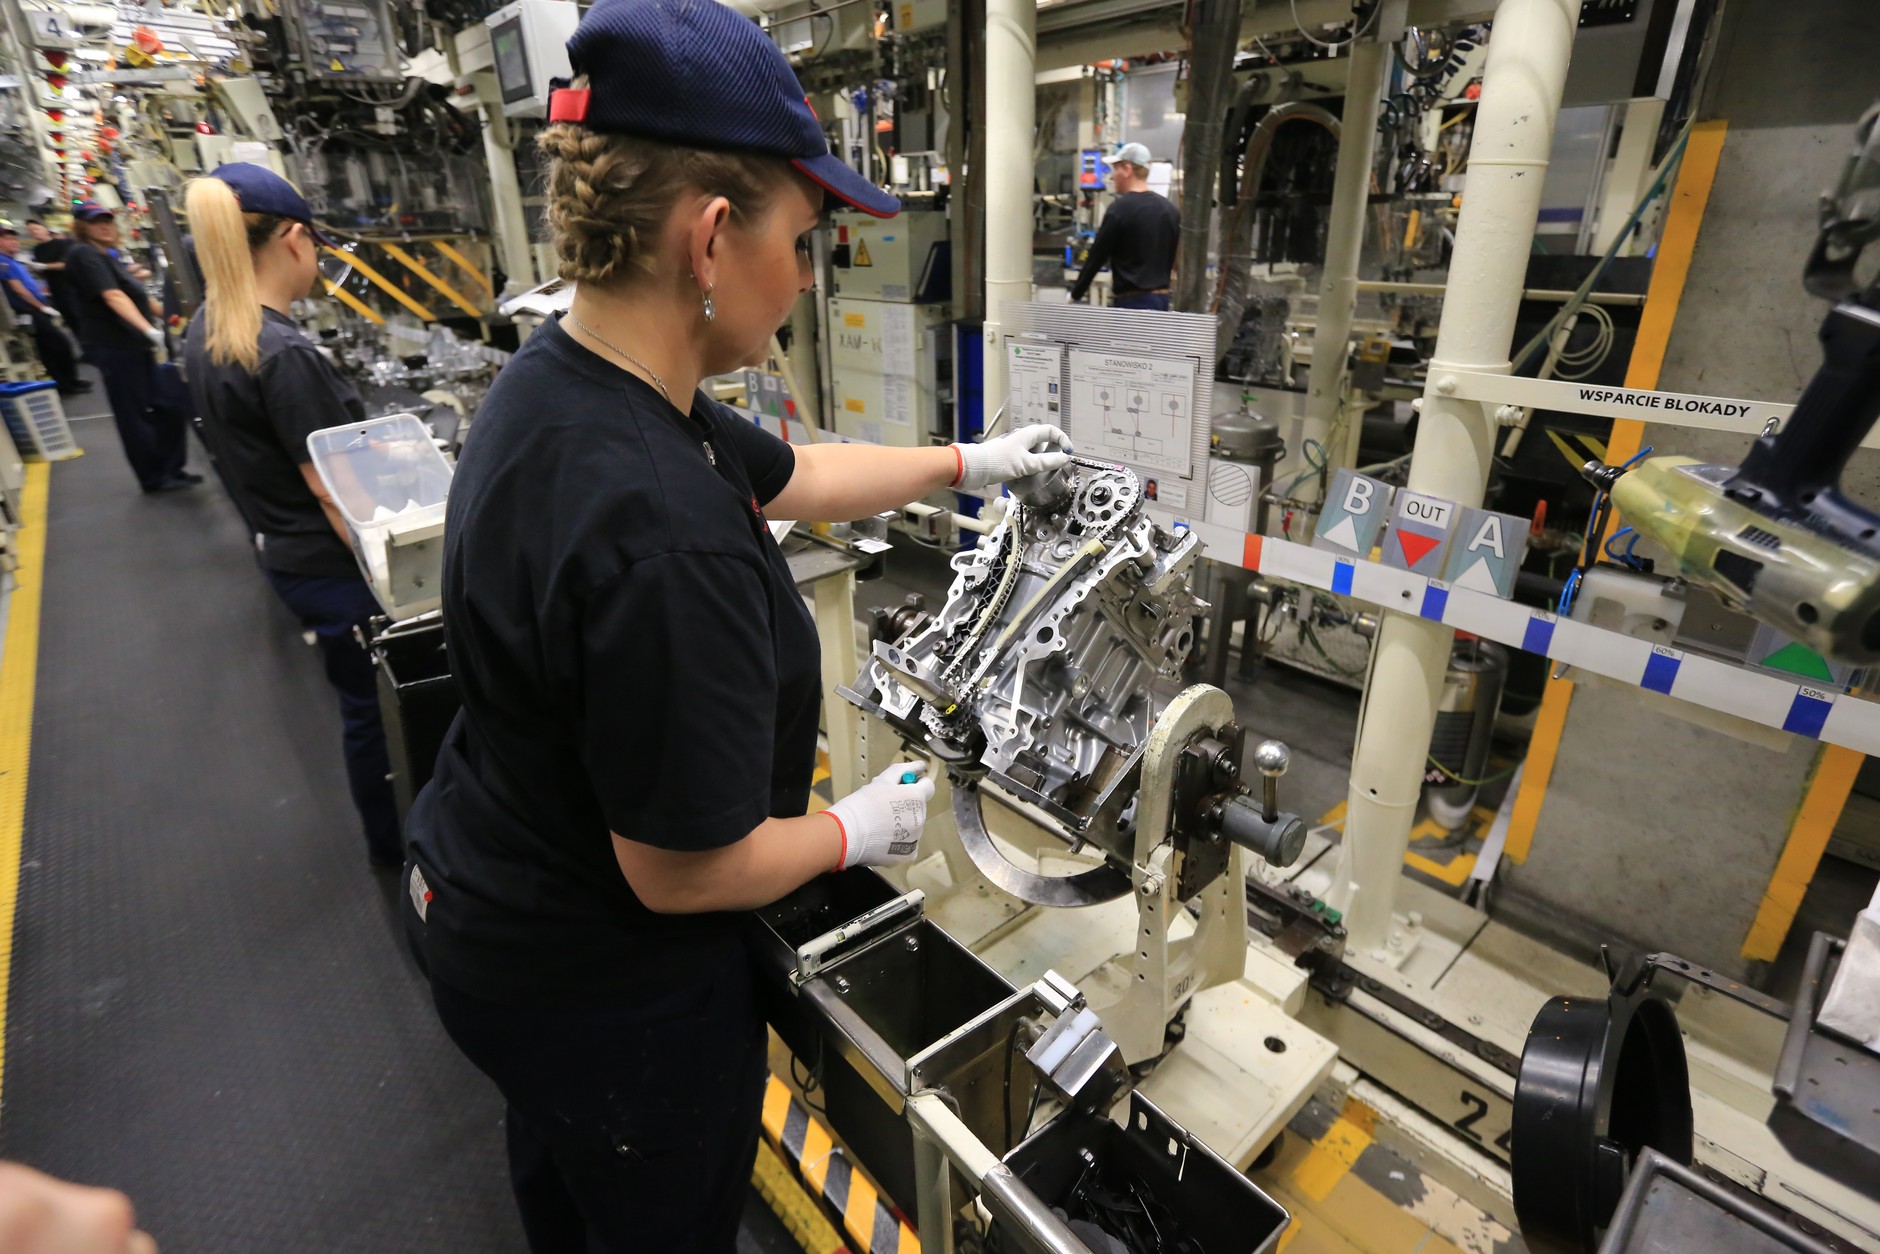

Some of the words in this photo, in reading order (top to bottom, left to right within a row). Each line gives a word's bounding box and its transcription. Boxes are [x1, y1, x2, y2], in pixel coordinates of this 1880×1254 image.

[1104, 359, 1147, 370] STANOWISKO
[748, 372, 758, 392] B
[1580, 389, 1660, 408] WSPARCIE
[1664, 398, 1751, 417] BLOKADY
[1343, 476, 1374, 515] B
[1406, 500, 1445, 522] OUT
[1467, 515, 1505, 558] A
[1655, 646, 1675, 657] 60%
[1802, 687, 1826, 700] 50%
